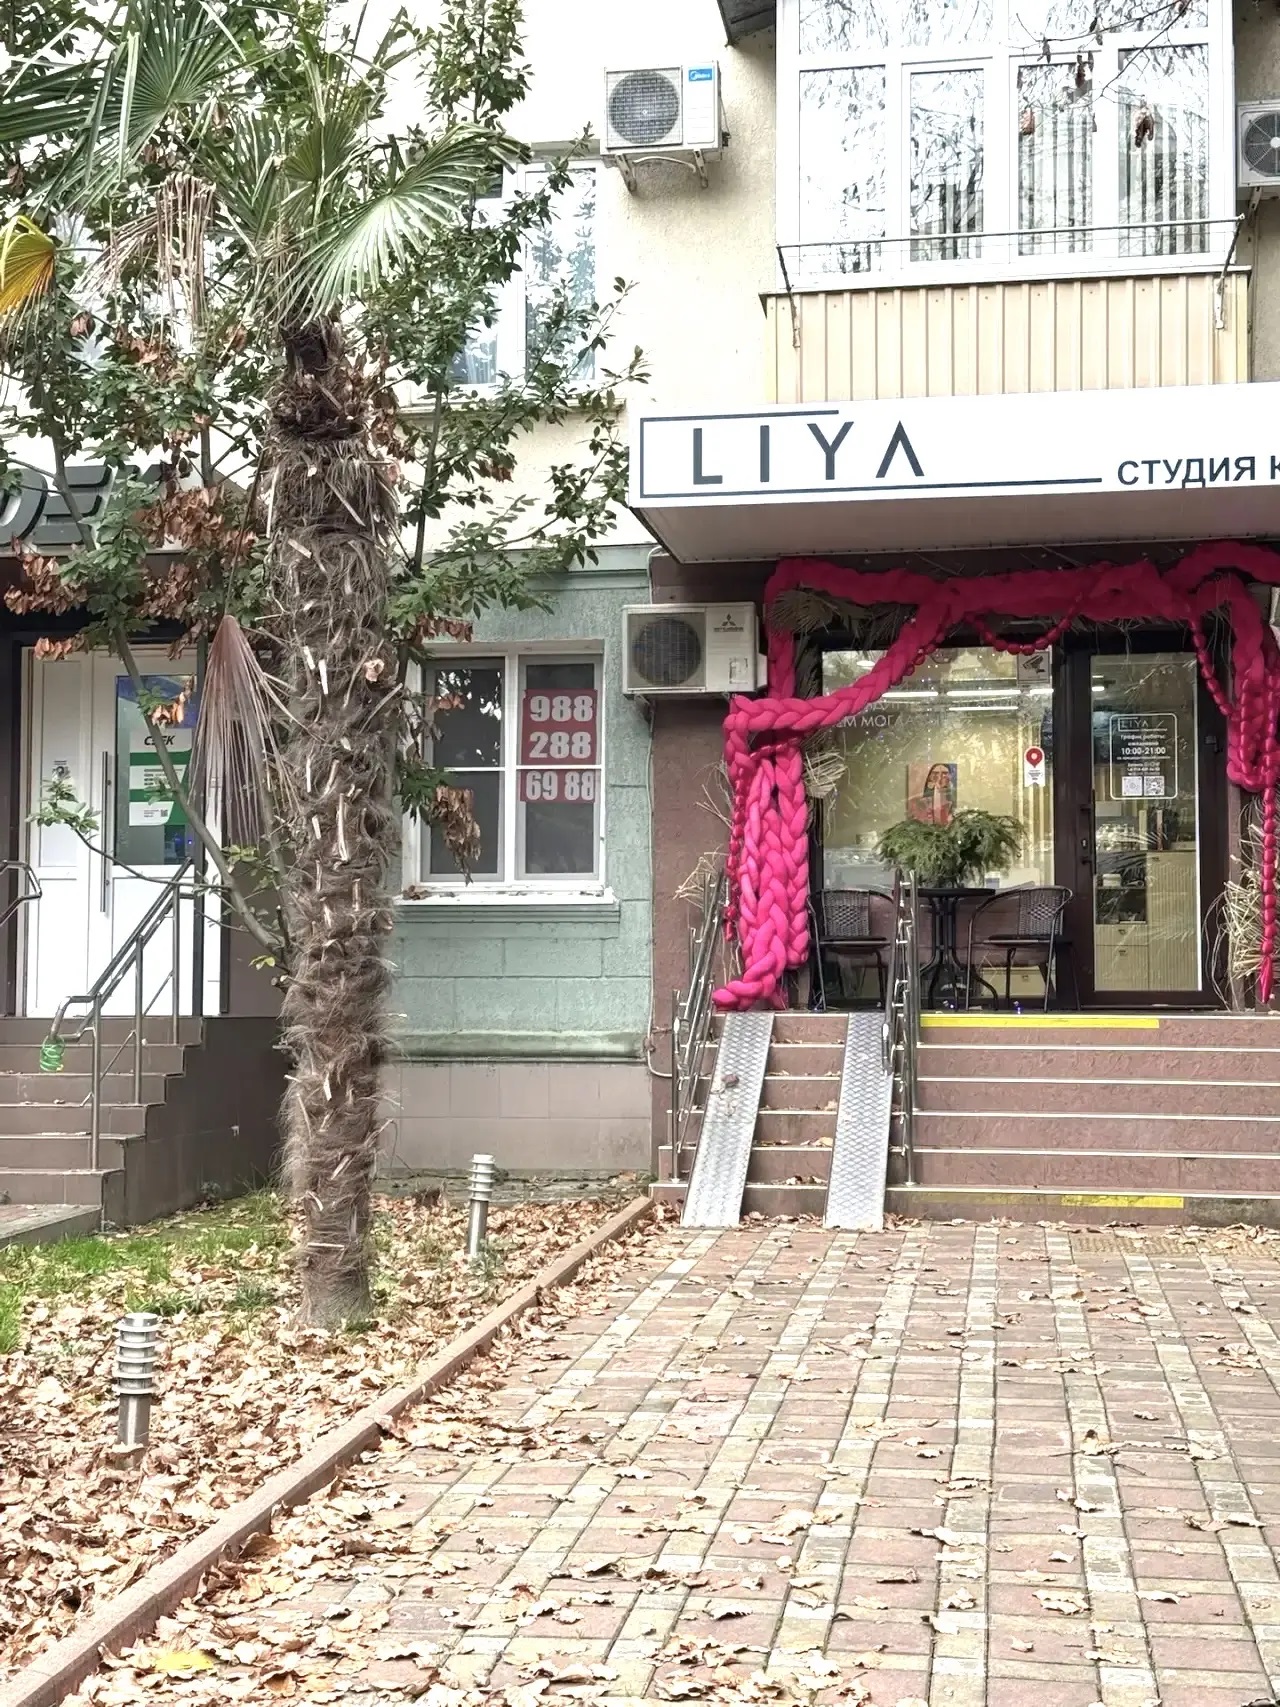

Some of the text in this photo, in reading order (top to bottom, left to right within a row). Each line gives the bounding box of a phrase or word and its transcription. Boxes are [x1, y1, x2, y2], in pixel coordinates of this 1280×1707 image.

[692, 420, 925, 485] LIYA
[1117, 456, 1256, 489] СТУДИЯ
[530, 695, 593, 722] 988
[529, 731, 591, 759] 288
[1121, 747, 1166, 755] 10:00-21:00
[526, 770, 595, 800] 69 88
